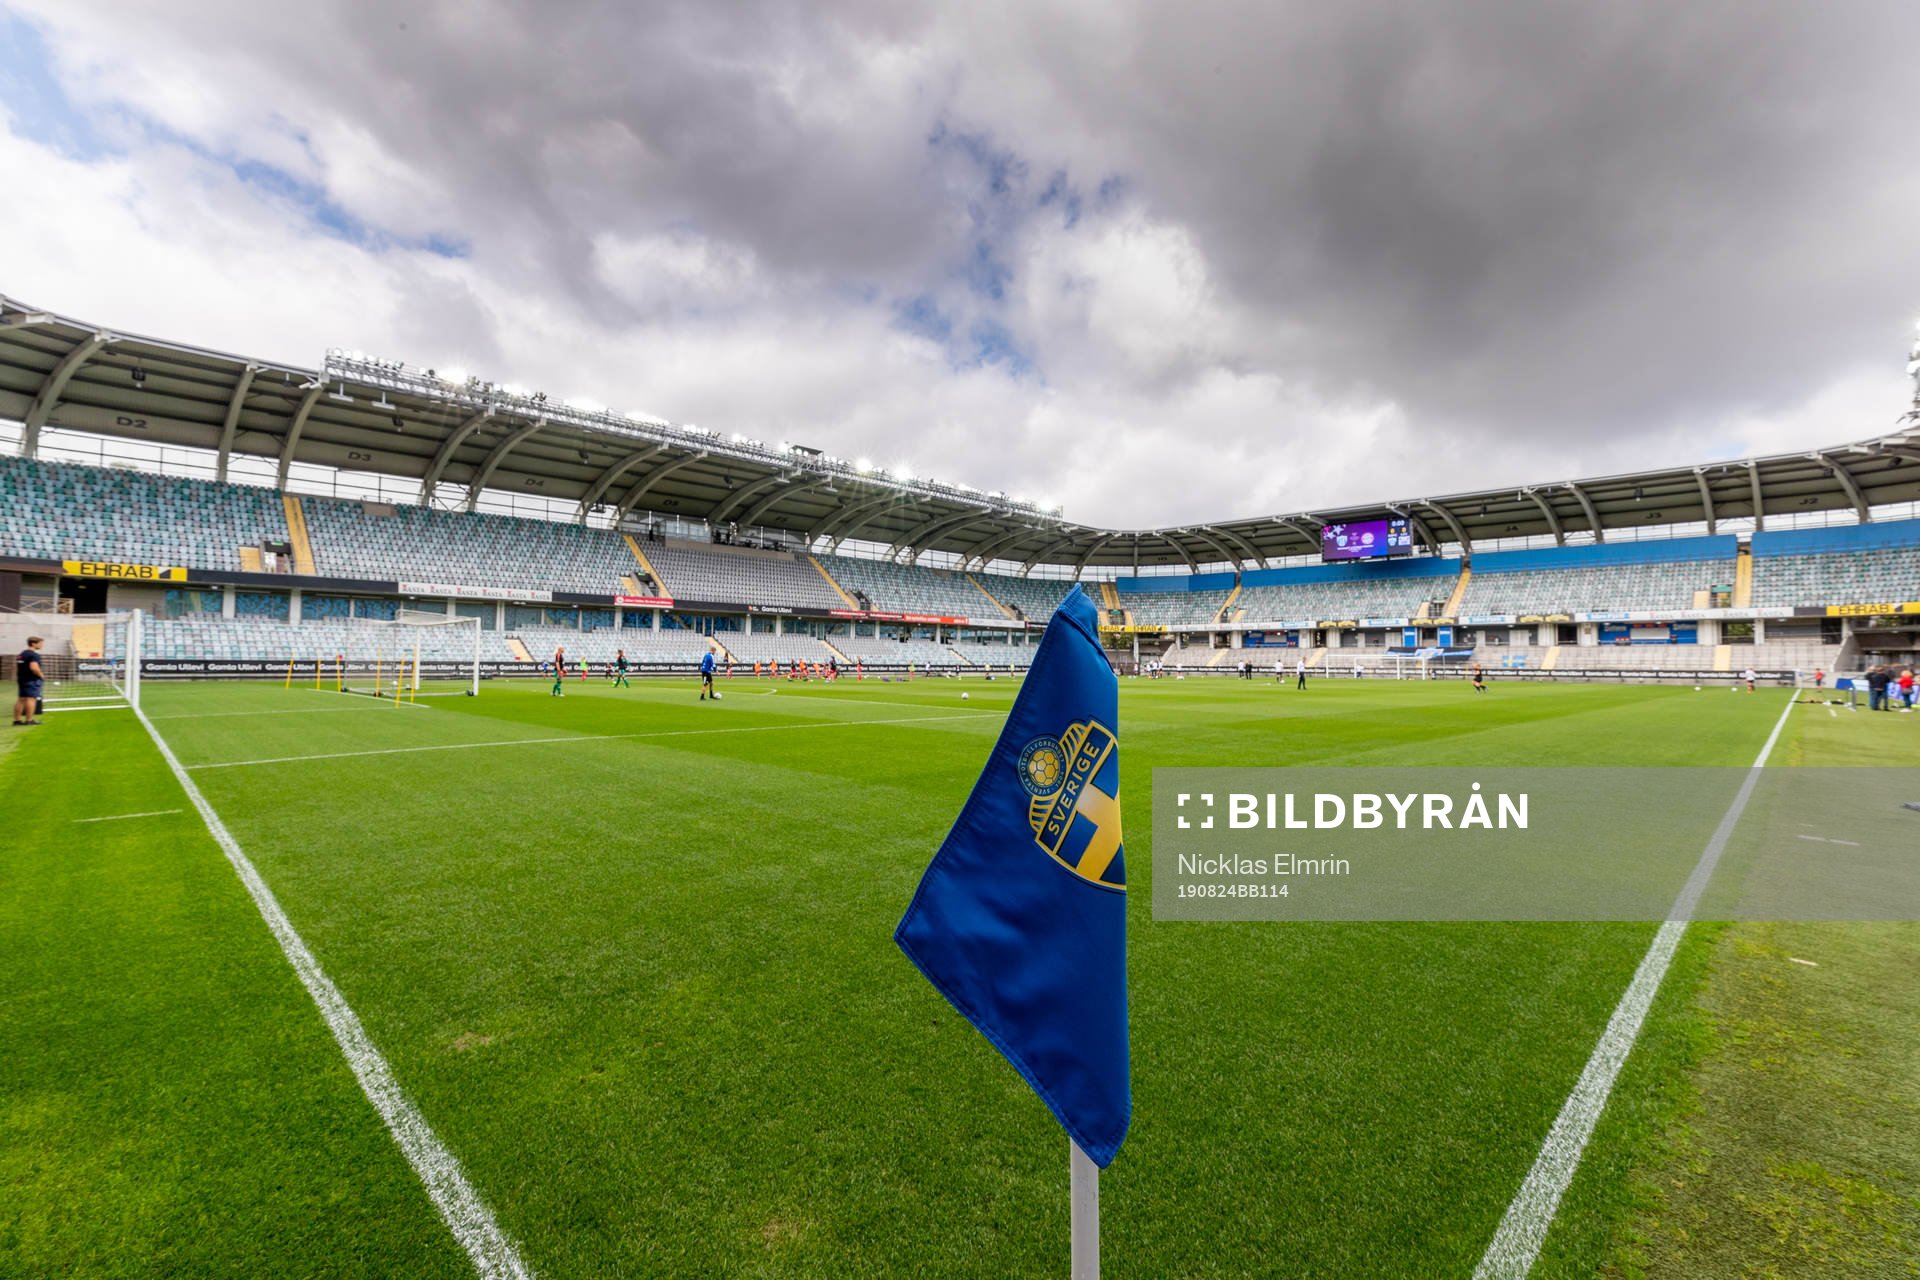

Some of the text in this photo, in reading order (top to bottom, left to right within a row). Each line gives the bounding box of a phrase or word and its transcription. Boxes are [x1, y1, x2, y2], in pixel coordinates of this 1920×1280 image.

[116, 417, 147, 428] D2
[348, 451, 372, 462] D3
[80, 562, 153, 579] EHRAB
[1838, 604, 1889, 615] EHRAB
[146, 663, 177, 671] Gamla
[178, 663, 204, 671] Ullevi
[1049, 741, 1100, 836] SVERIGE
